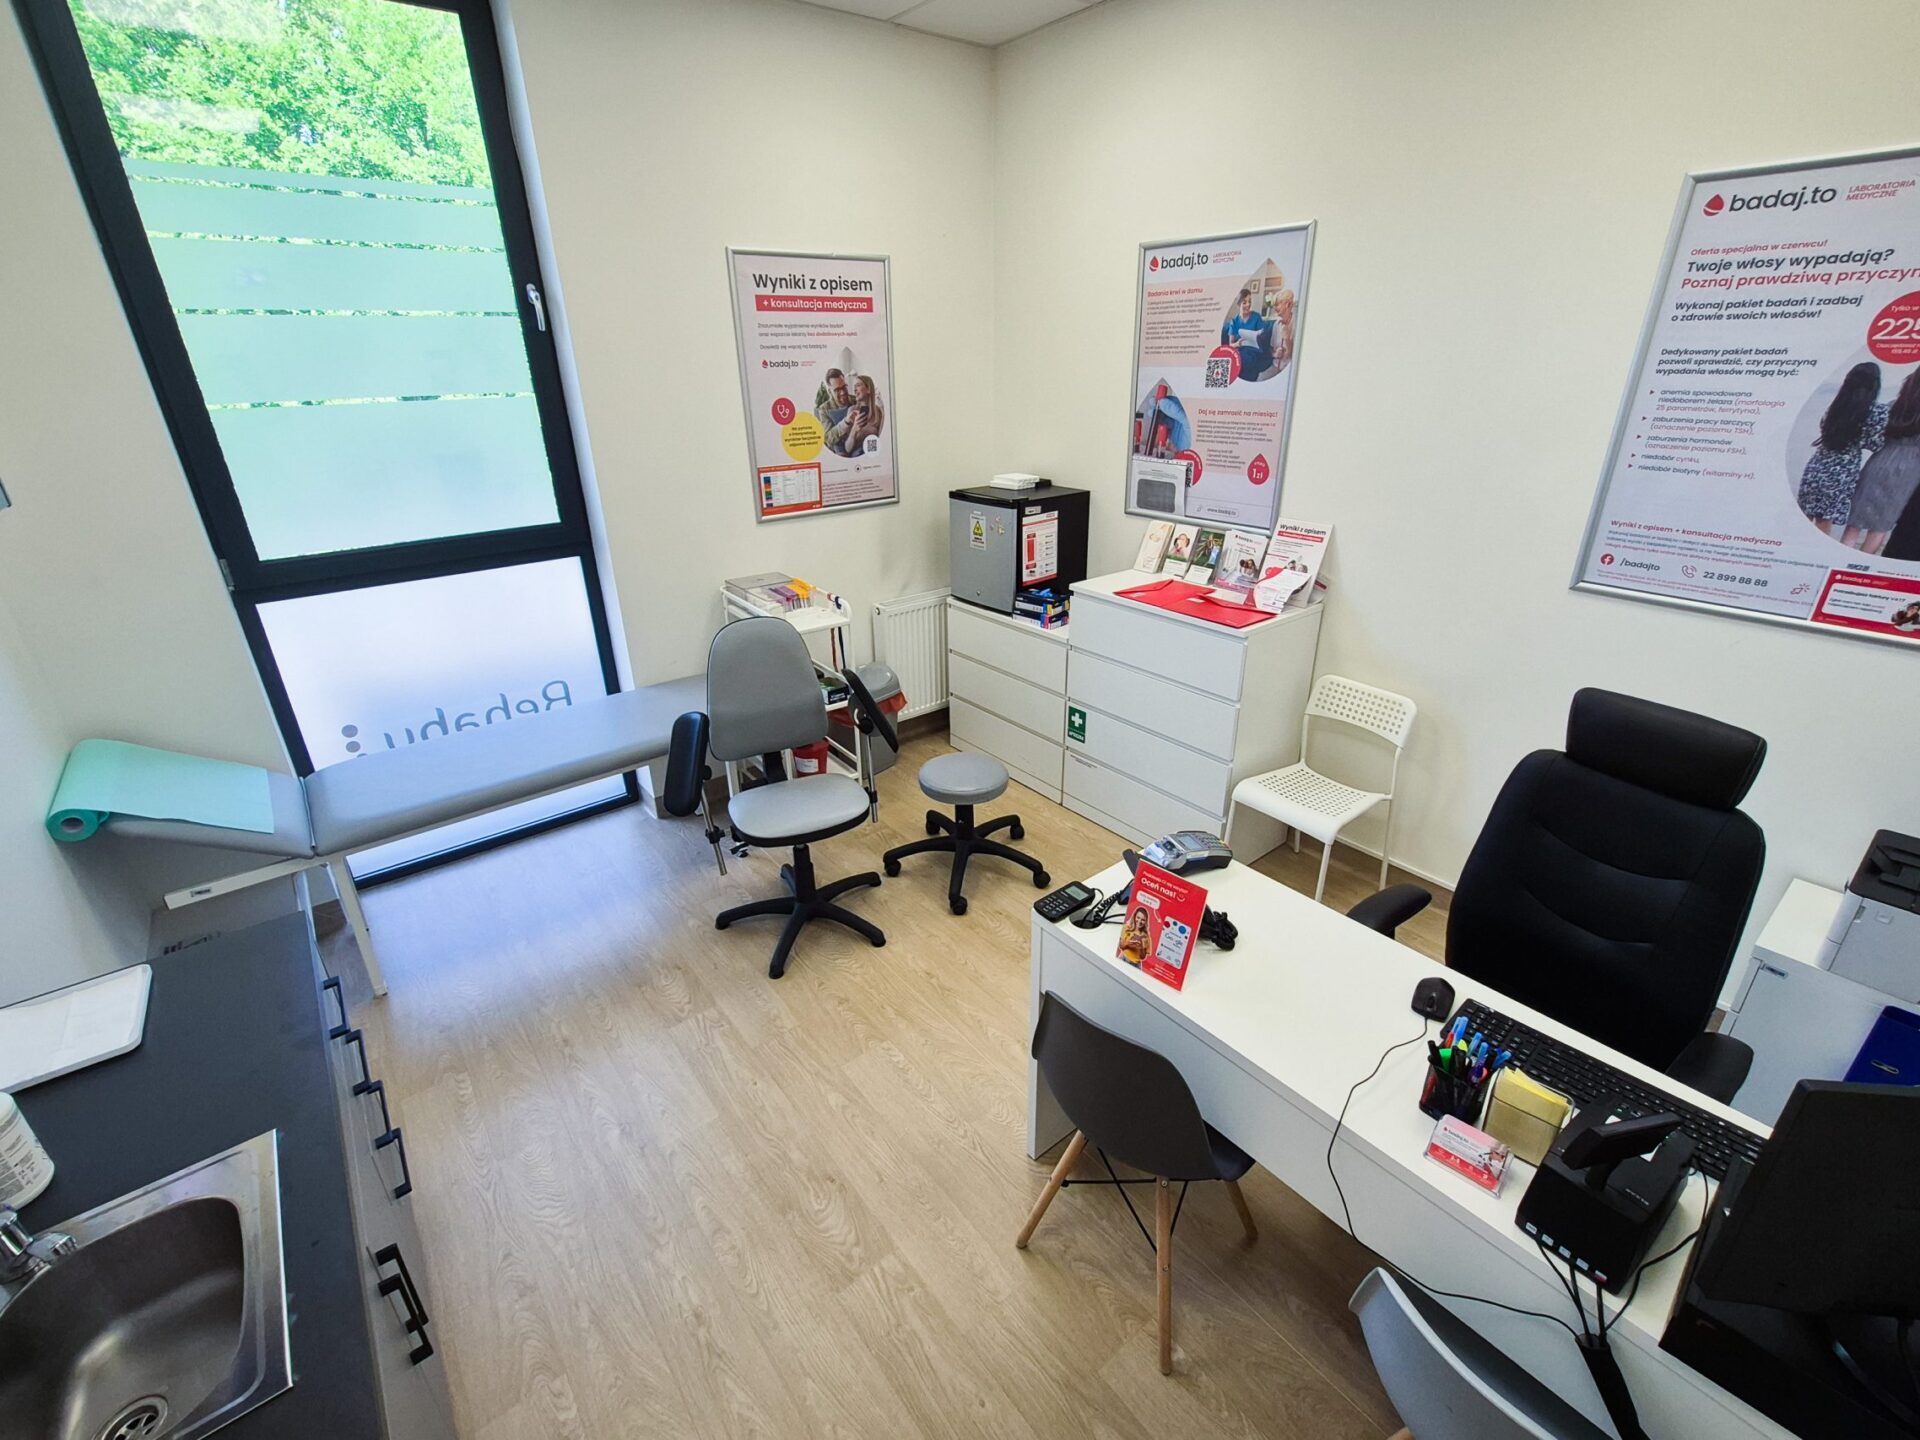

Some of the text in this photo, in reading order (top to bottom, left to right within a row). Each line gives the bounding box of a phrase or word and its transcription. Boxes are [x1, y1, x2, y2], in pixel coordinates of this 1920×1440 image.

[1849, 179, 1916, 193] LABORATORIA
[1728, 186, 1837, 212] badaj.to
[1846, 190, 1899, 201] MEDYCZNE
[1690, 247, 1720, 256] Oferta
[1721, 244, 1768, 256] specjalna
[1781, 240, 1828, 249] czerwcu!
[1161, 252, 1209, 270] badaj.to
[1687, 248, 1895, 275] Twoje włosy wypadają?
[752, 273, 873, 295] Wyniki z opisem
[1681, 276, 1733, 290] Poznaj
[1735, 270, 1832, 289] prawdziwą
[770, 298, 823, 311] konsultacja
[824, 299, 868, 311] medyczna
[1676, 295, 1864, 311] Wykonaj pakiet badań i zadbaj
[1680, 312, 1724, 322] zdrowie
[1726, 310, 1768, 320] swoich
[1769, 309, 1822, 319] włosów!
[1661, 347, 1788, 357] Dedykowany pakiet badań
[769, 360, 799, 369] badaj.to
[1658, 357, 1817, 367] pozwoli sprawdzić, czy przyczyną
[1656, 367, 1800, 377] wypadania włosów mogą być:
[1692, 389, 1752, 398] spowodowana
[1707, 398, 1733, 406] żelaza
[1734, 398, 1786, 408] (morfologia
[1652, 416, 1756, 427] zaburzenia pracy tarczycy
[1650, 424, 1696, 433] (oznaczenie
[1697, 426, 1732, 434] poziomu
[1647, 435, 1732, 445] zaburzenia hormonów
[1645, 442, 1690, 451] (oznaczenie
[1691, 444, 1725, 453] poziomu
[1641, 453, 1675, 462] niedobór
[1638, 464, 1671, 472] niedobór
[1672, 467, 1701, 476] biotyny
[1702, 468, 1743, 479] (witaminy
[1610, 519, 1637, 530] Wyniki
[1643, 524, 1673, 533] opisem
[1681, 527, 1732, 541] konsultacja
[1734, 535, 1782, 546] medyczna
[1620, 557, 1660, 571] /badajto
[1703, 571, 1715, 580] 22
[1717, 573, 1736, 582] 899
[1738, 576, 1752, 585] 88
[1754, 578, 1768, 587] 88
[1141, 878, 1177, 898] Oceń nas!
